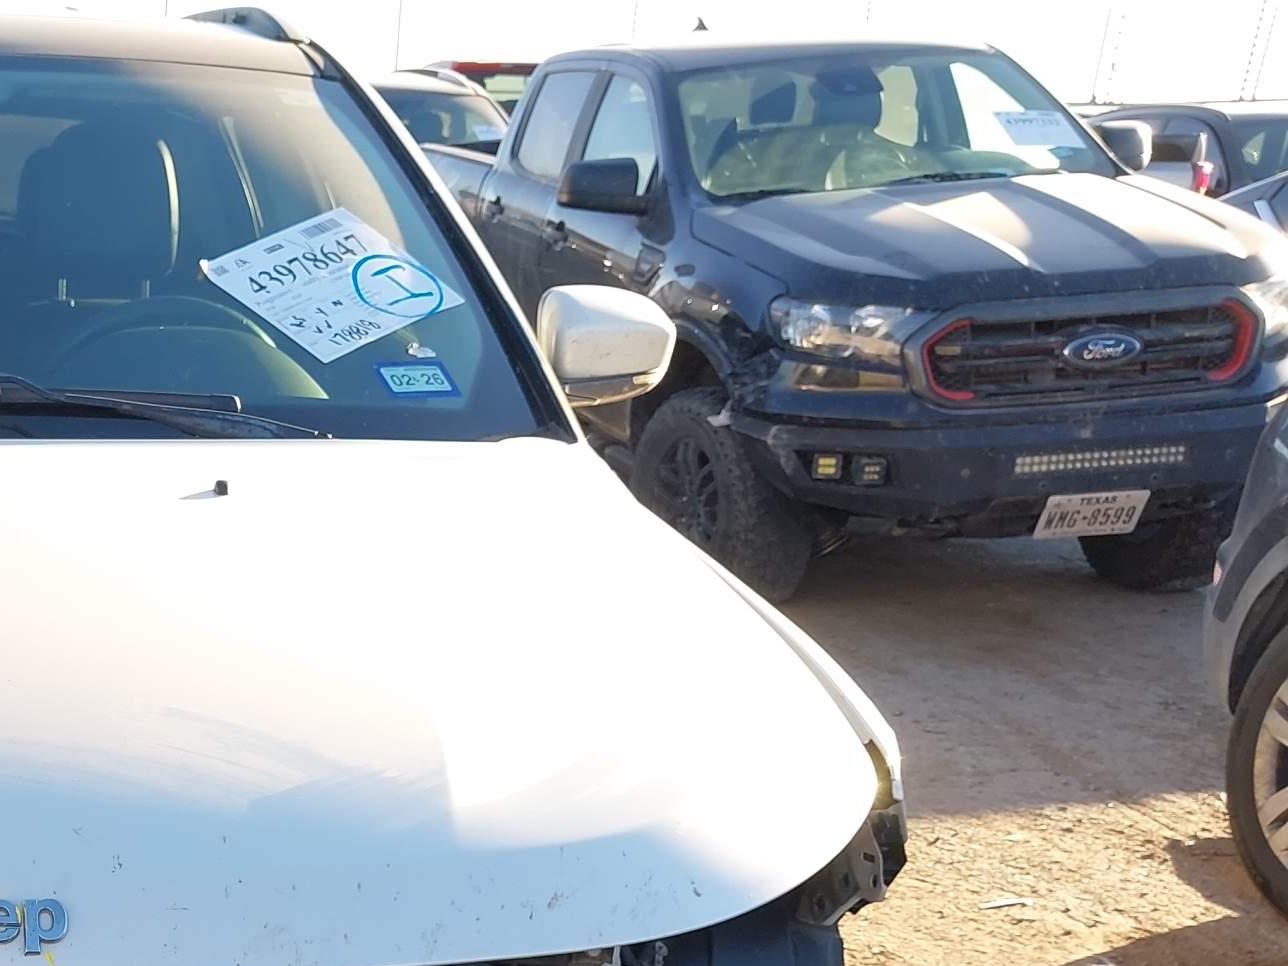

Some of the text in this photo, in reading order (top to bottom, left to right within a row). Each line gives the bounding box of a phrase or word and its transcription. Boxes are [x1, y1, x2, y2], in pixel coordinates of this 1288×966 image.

[248, 234, 368, 295] 43978647
[1083, 340, 1125, 360] Ford
[1079, 495, 1118, 506] TEXAS
